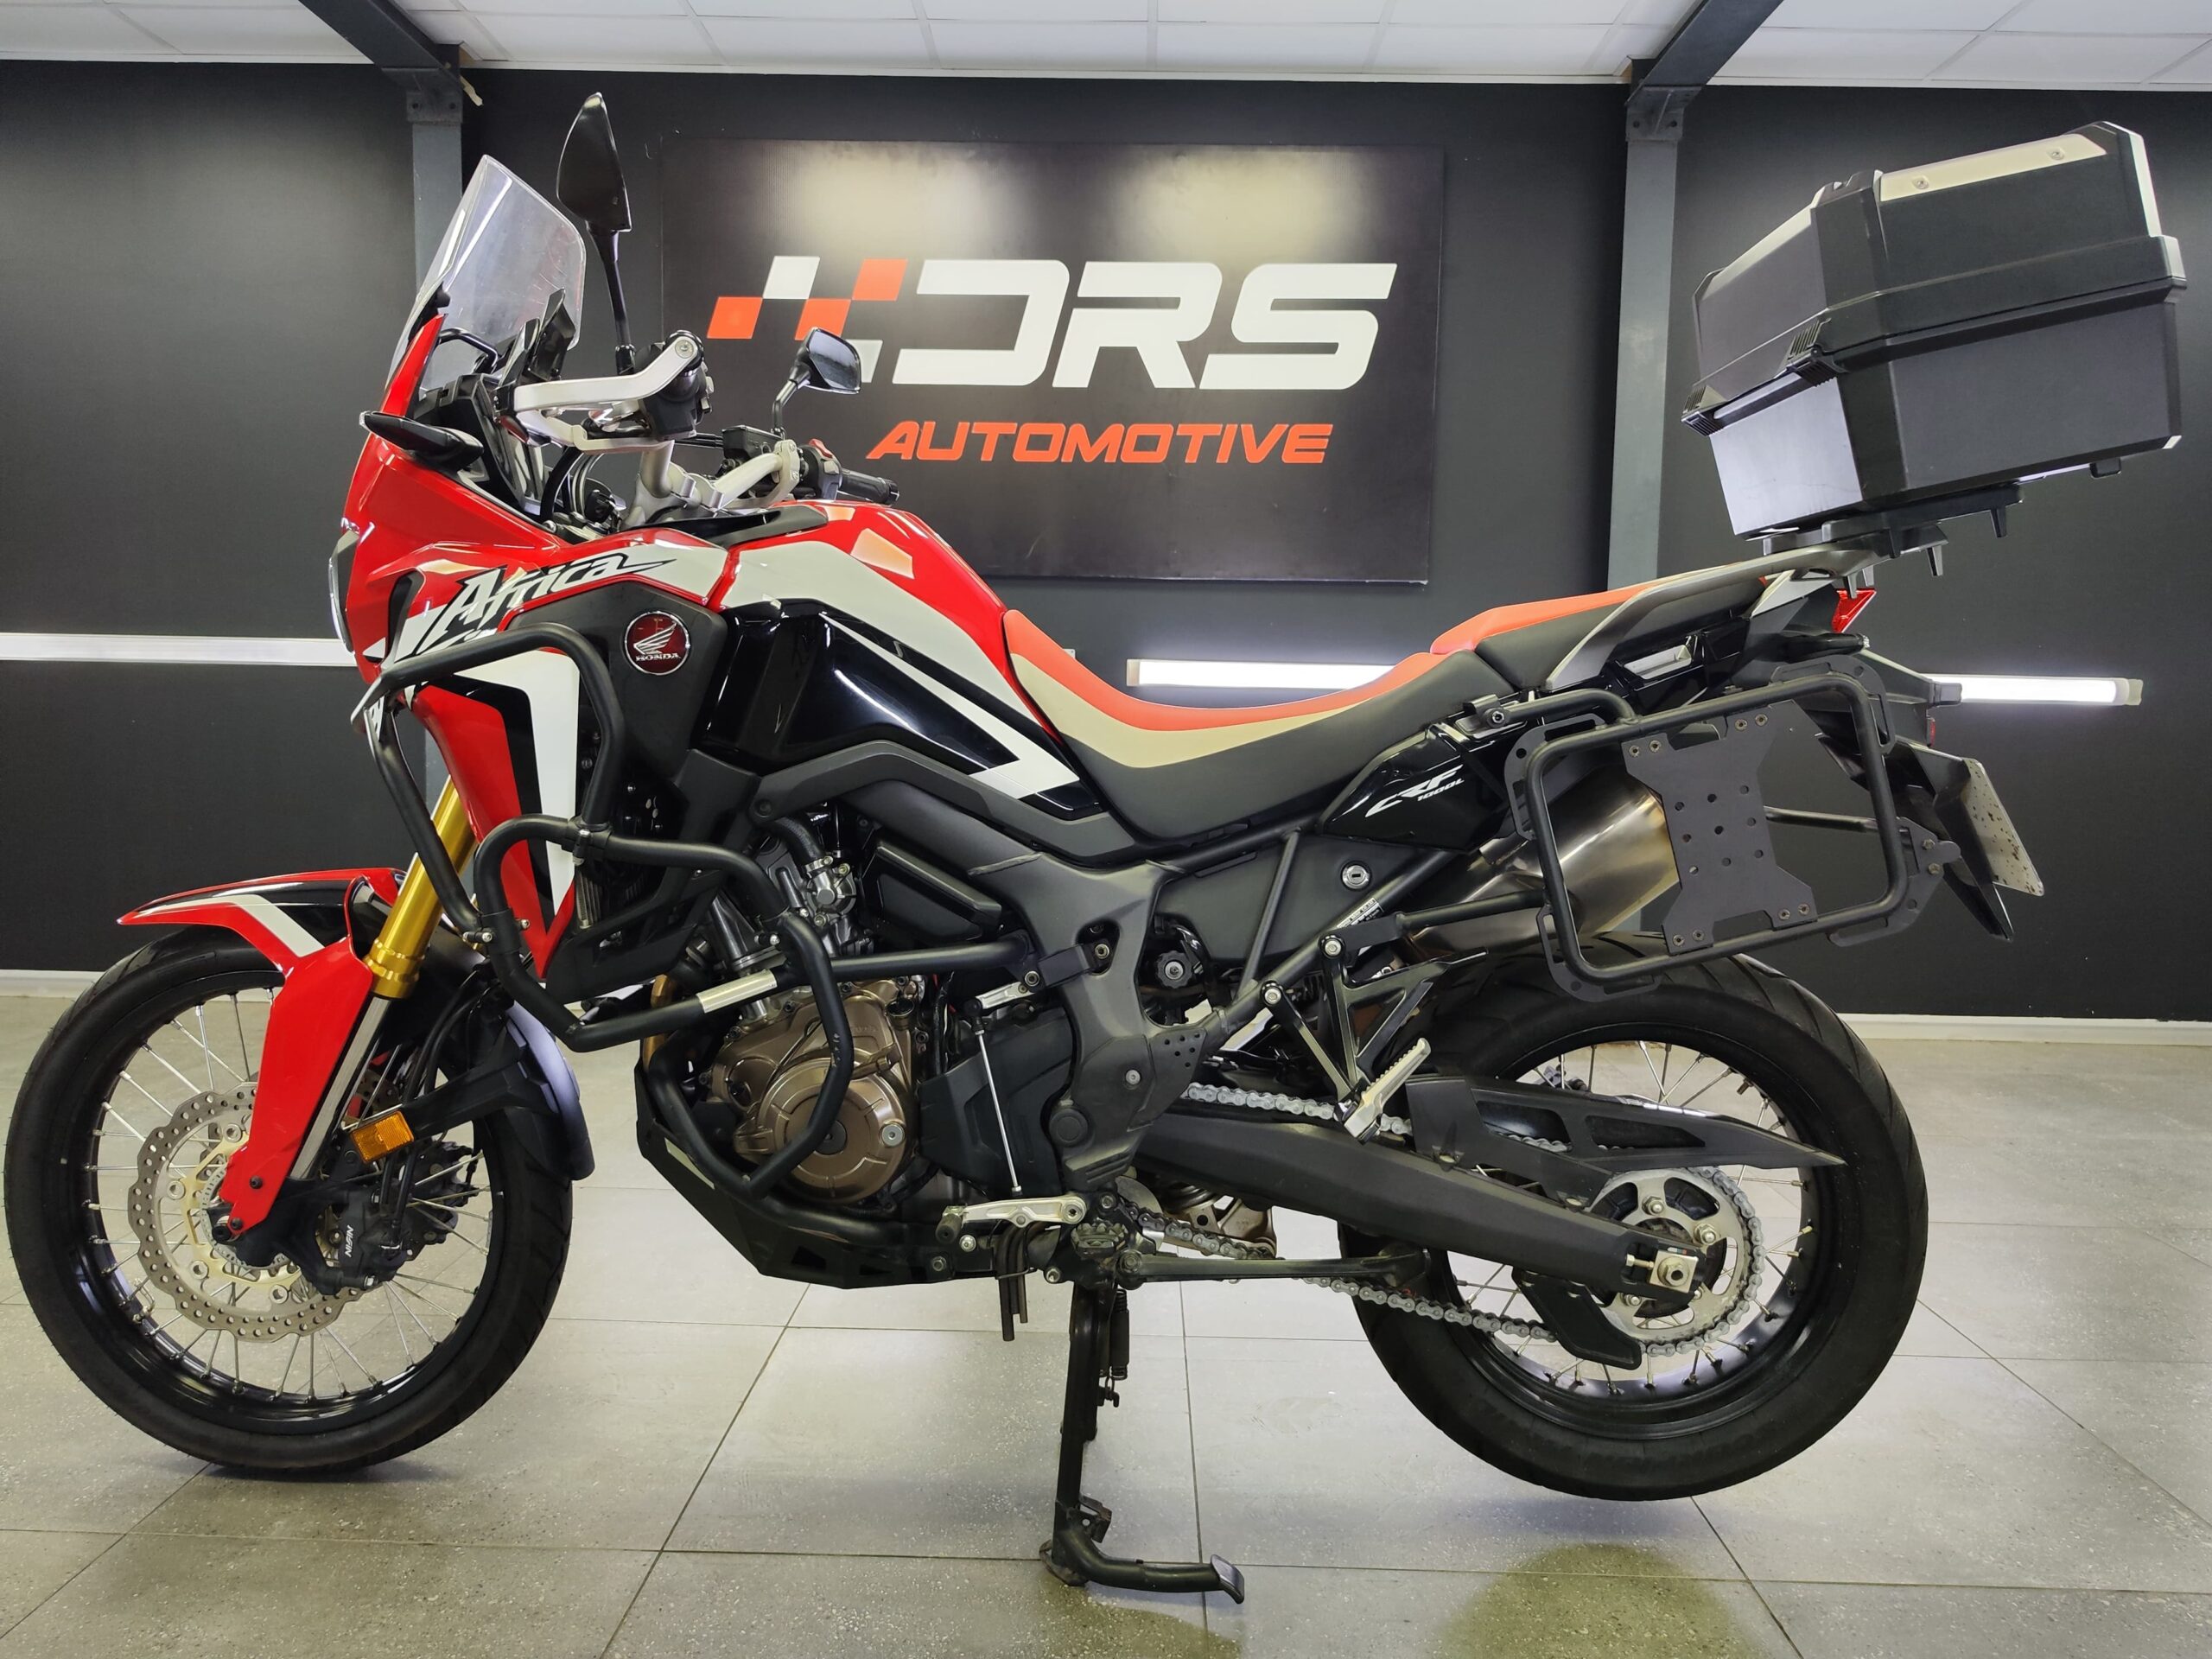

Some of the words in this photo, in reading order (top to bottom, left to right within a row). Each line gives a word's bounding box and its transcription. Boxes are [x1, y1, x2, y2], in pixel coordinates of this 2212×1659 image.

[892, 259, 1397, 390] DRS
[866, 421, 1333, 464] AUTOMOTIVE
[635, 652, 682, 662] HONDA
[1364, 764, 1464, 818] CRF
[1417, 778, 1465, 801] 1000L
